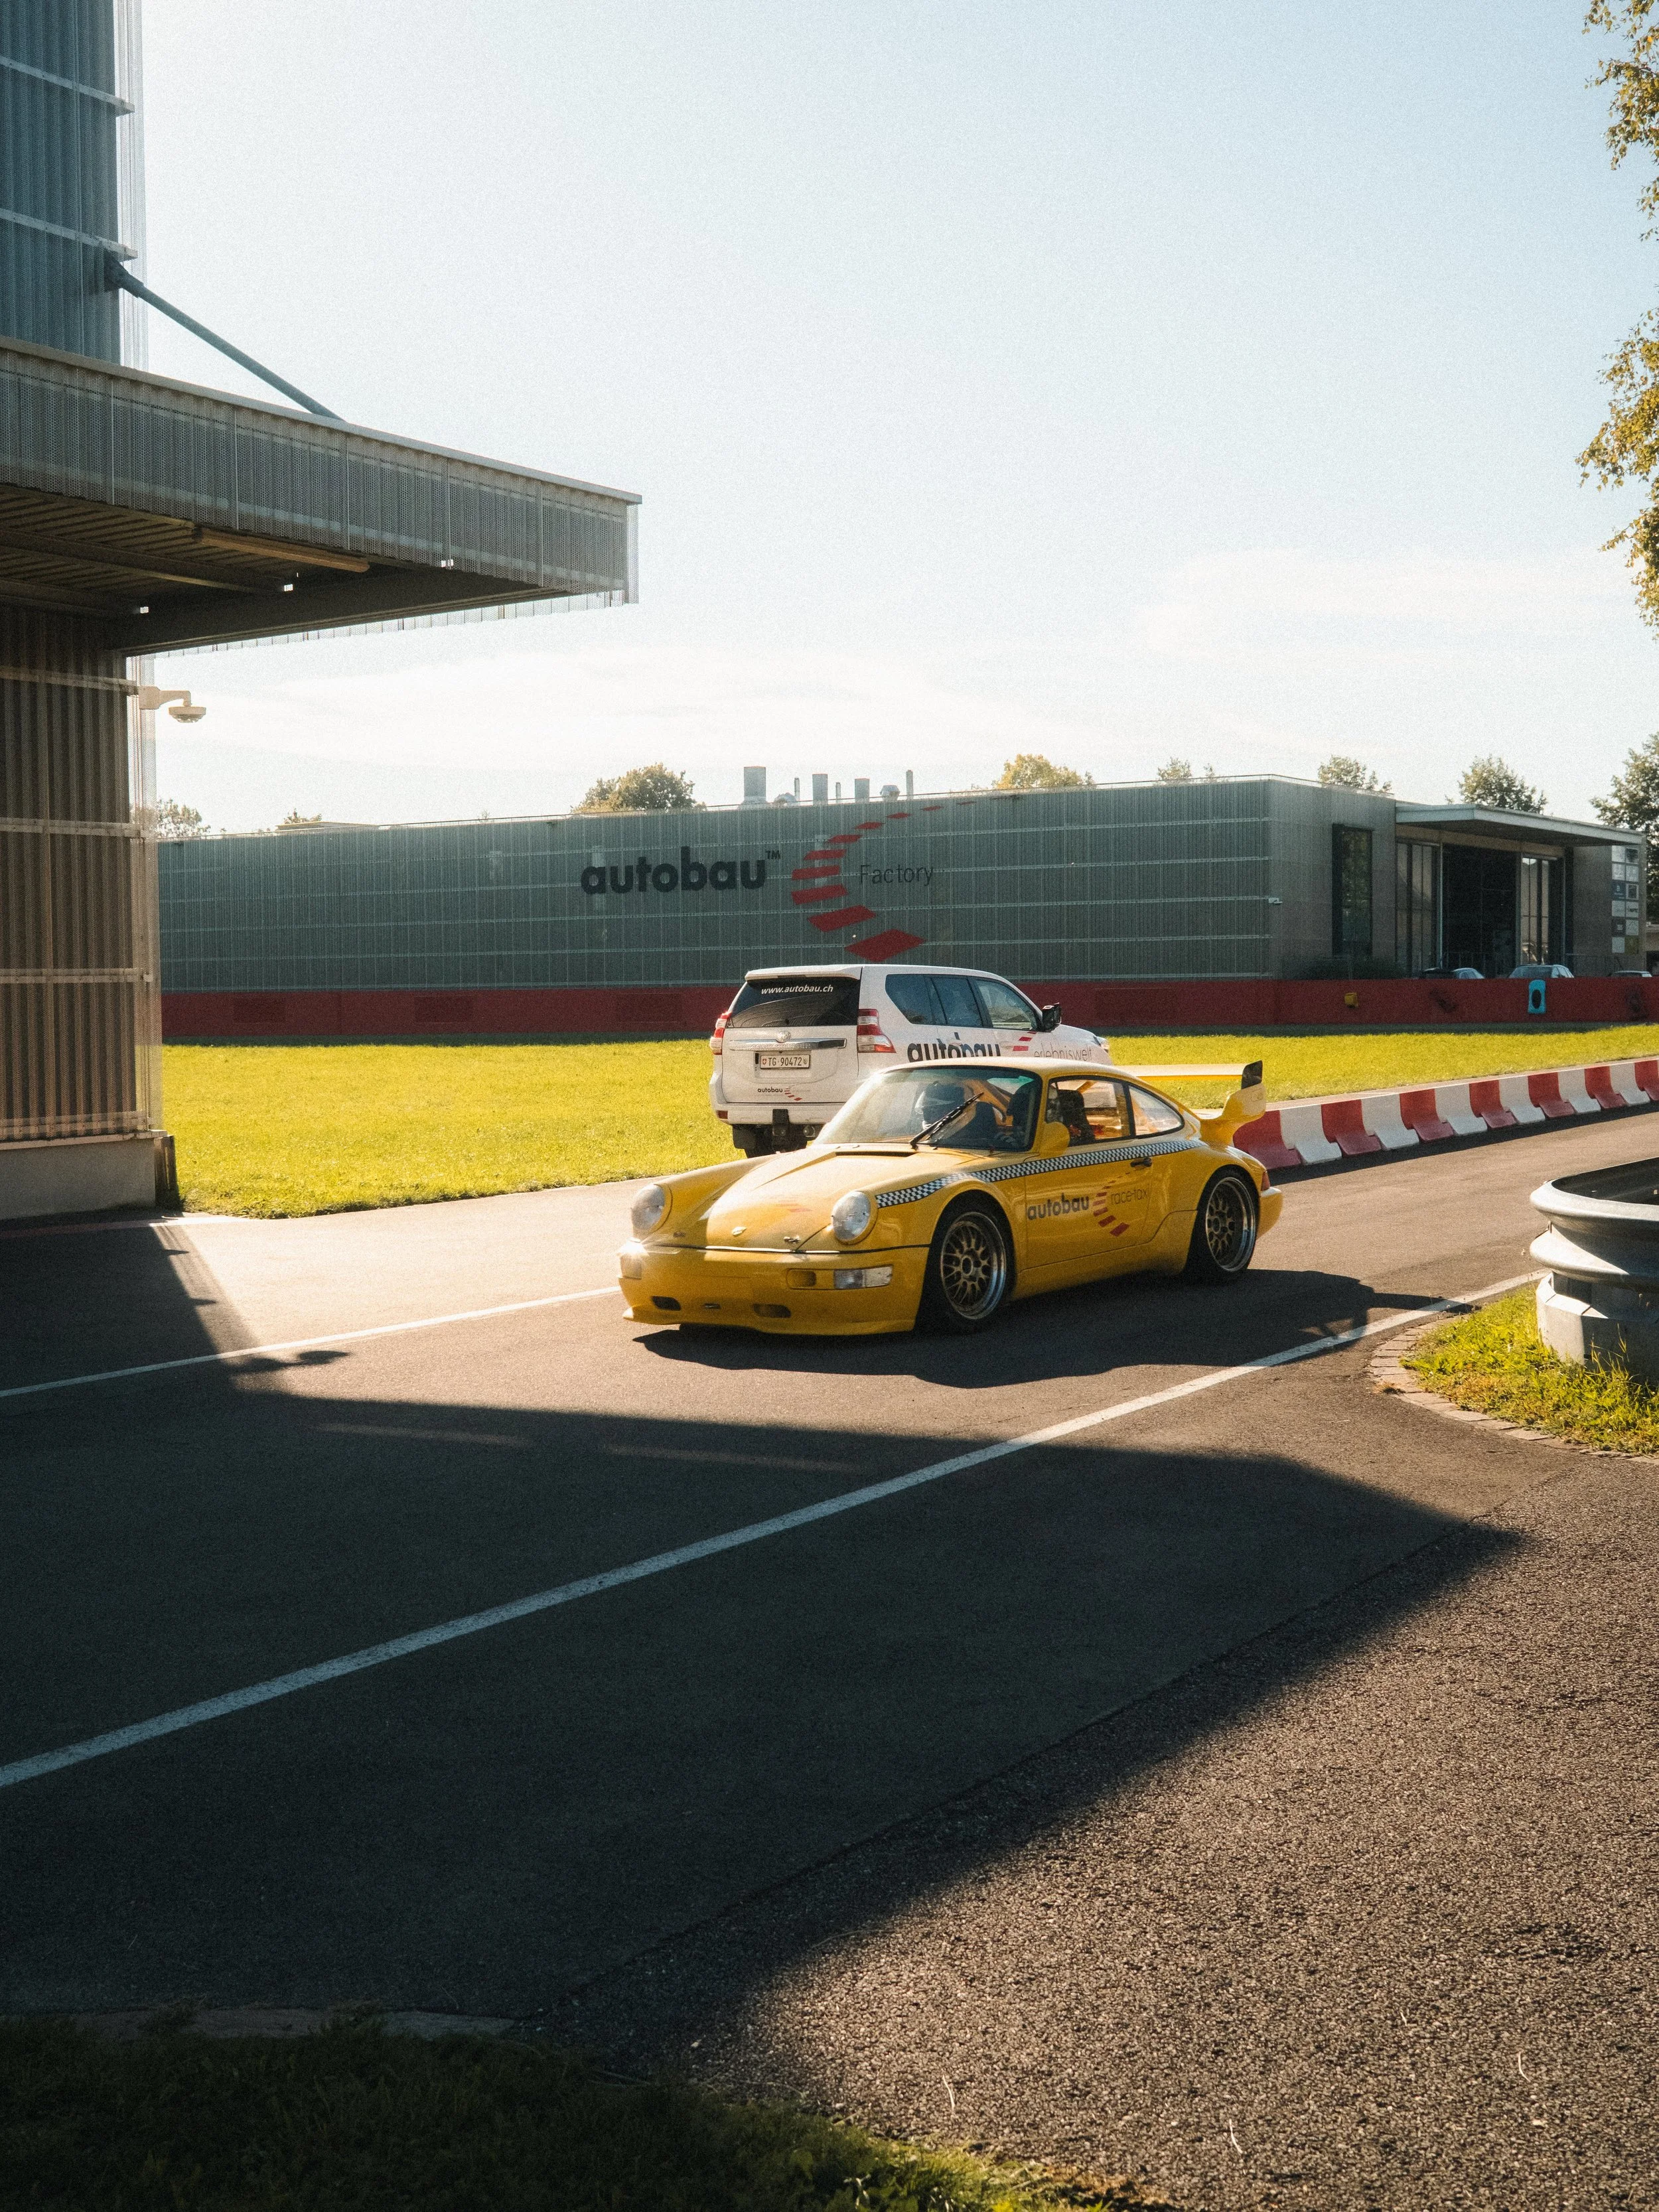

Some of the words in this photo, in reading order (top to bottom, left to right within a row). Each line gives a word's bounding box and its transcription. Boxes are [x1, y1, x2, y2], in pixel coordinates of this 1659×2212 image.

[580, 846, 766, 895] autobau
[859, 864, 934, 886] Factory
[761, 985, 833, 995] www.autobau.ch
[780, 1057, 802, 1066] 90472
[1027, 1192, 1090, 1220] autobau
